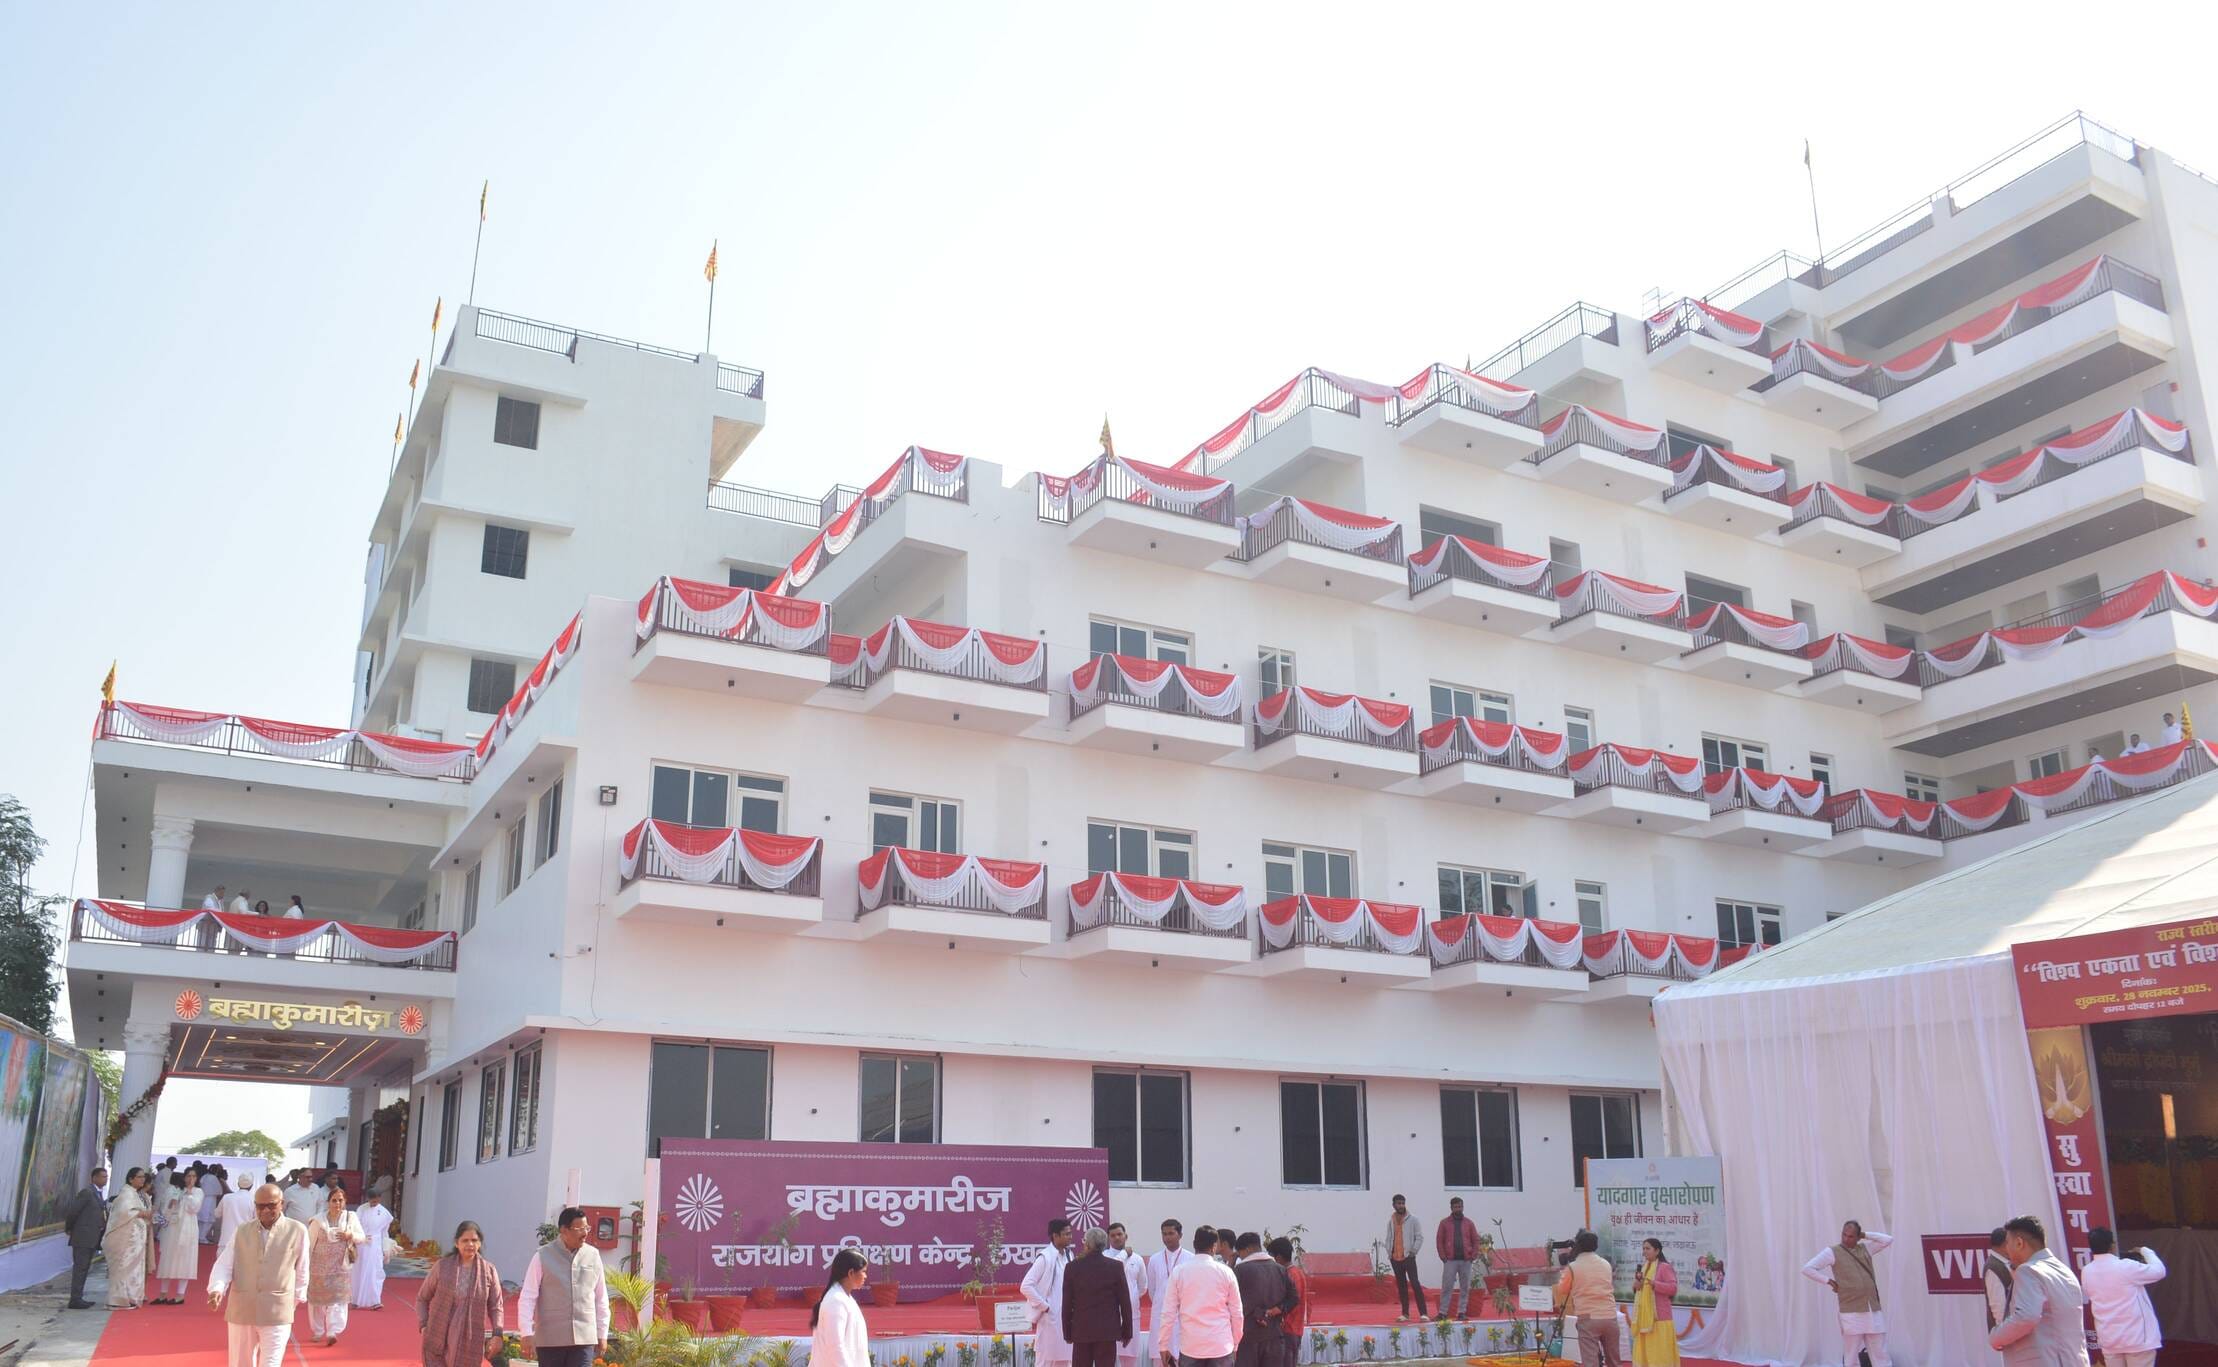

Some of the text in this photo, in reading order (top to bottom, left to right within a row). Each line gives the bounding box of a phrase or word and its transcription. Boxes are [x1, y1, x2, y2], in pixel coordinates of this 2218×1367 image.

[2188, 920, 2218, 937] स्तरी
[2085, 954, 2140, 977] एकता
[2144, 943, 2177, 969] एवं
[2123, 991, 2136, 1001] 28
[2157, 1000, 2166, 1009] 12
[786, 1175, 1012, 1227] ब्रह्माकुमारीज
[1596, 1180, 1716, 1212] यादगार वृक्षारोपण
[711, 1238, 816, 1267] राजयोग
[1931, 1248, 1992, 1280] VVI
